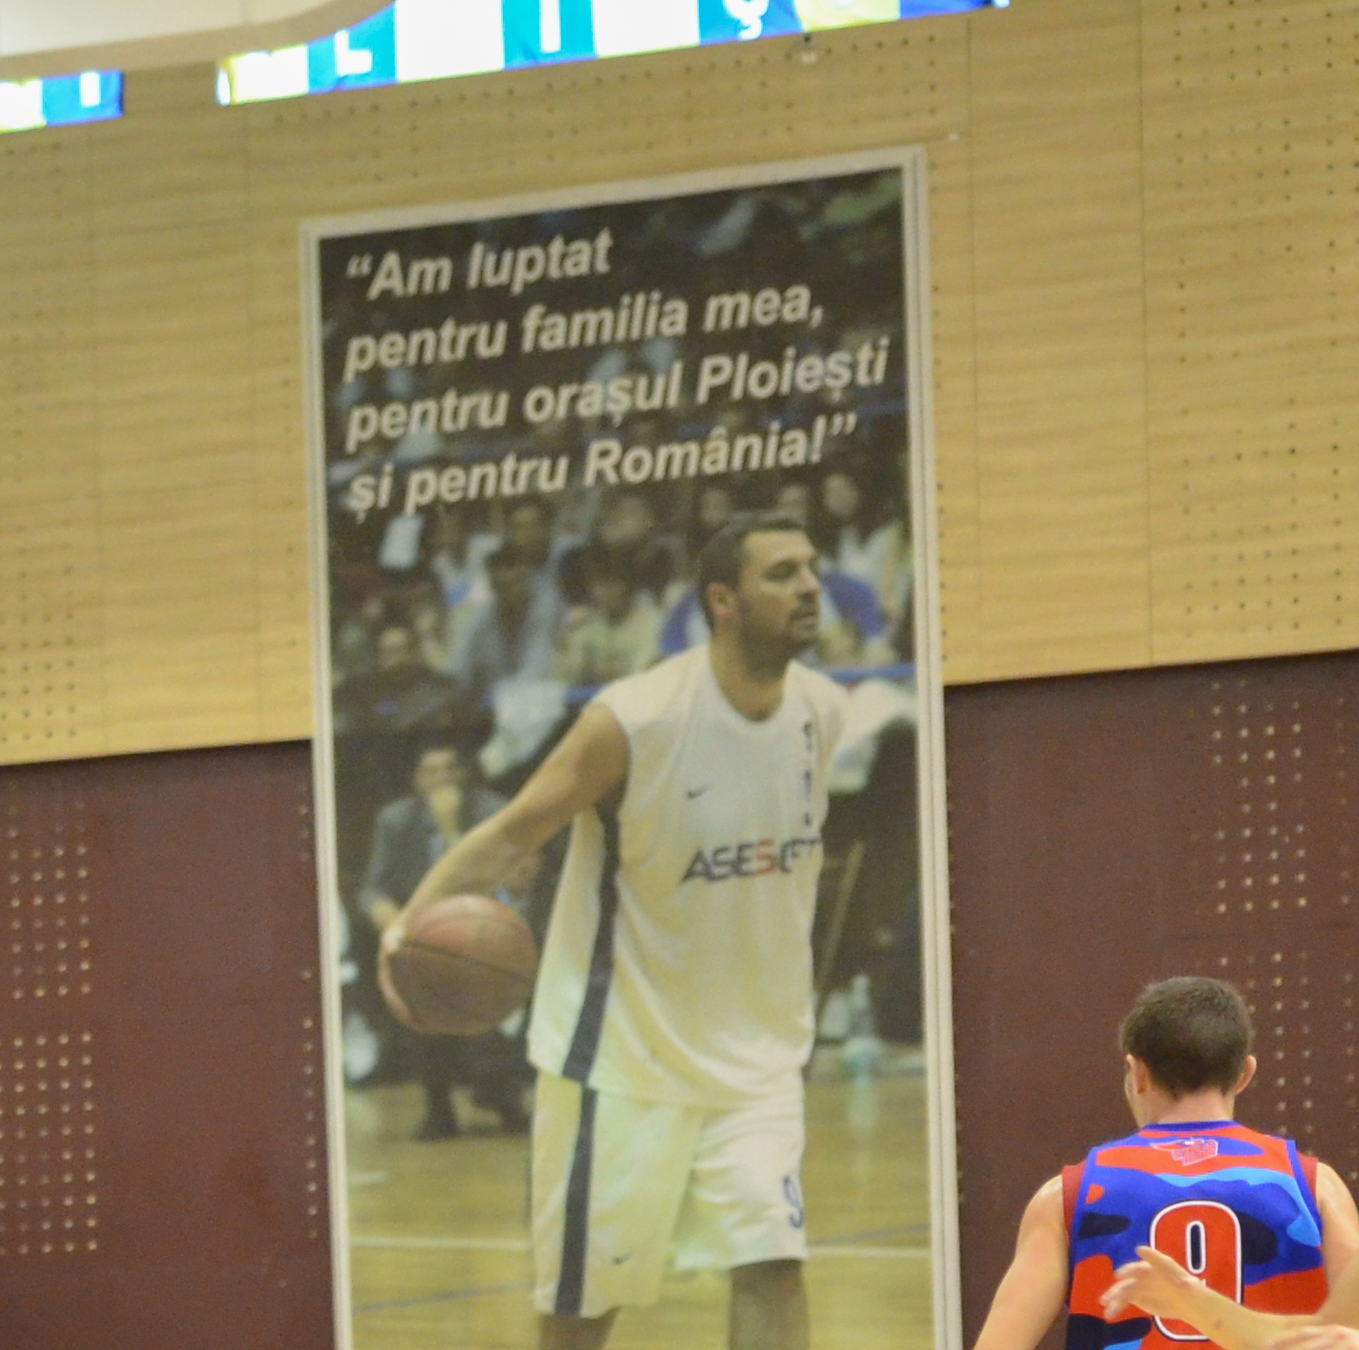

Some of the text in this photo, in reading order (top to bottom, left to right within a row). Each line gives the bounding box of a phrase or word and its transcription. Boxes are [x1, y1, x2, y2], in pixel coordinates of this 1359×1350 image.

[466, 227, 615, 297] luptat
[344, 283, 825, 383] pentru familia mea,
[346, 385, 509, 454] pentru
[404, 448, 569, 516] pentru
